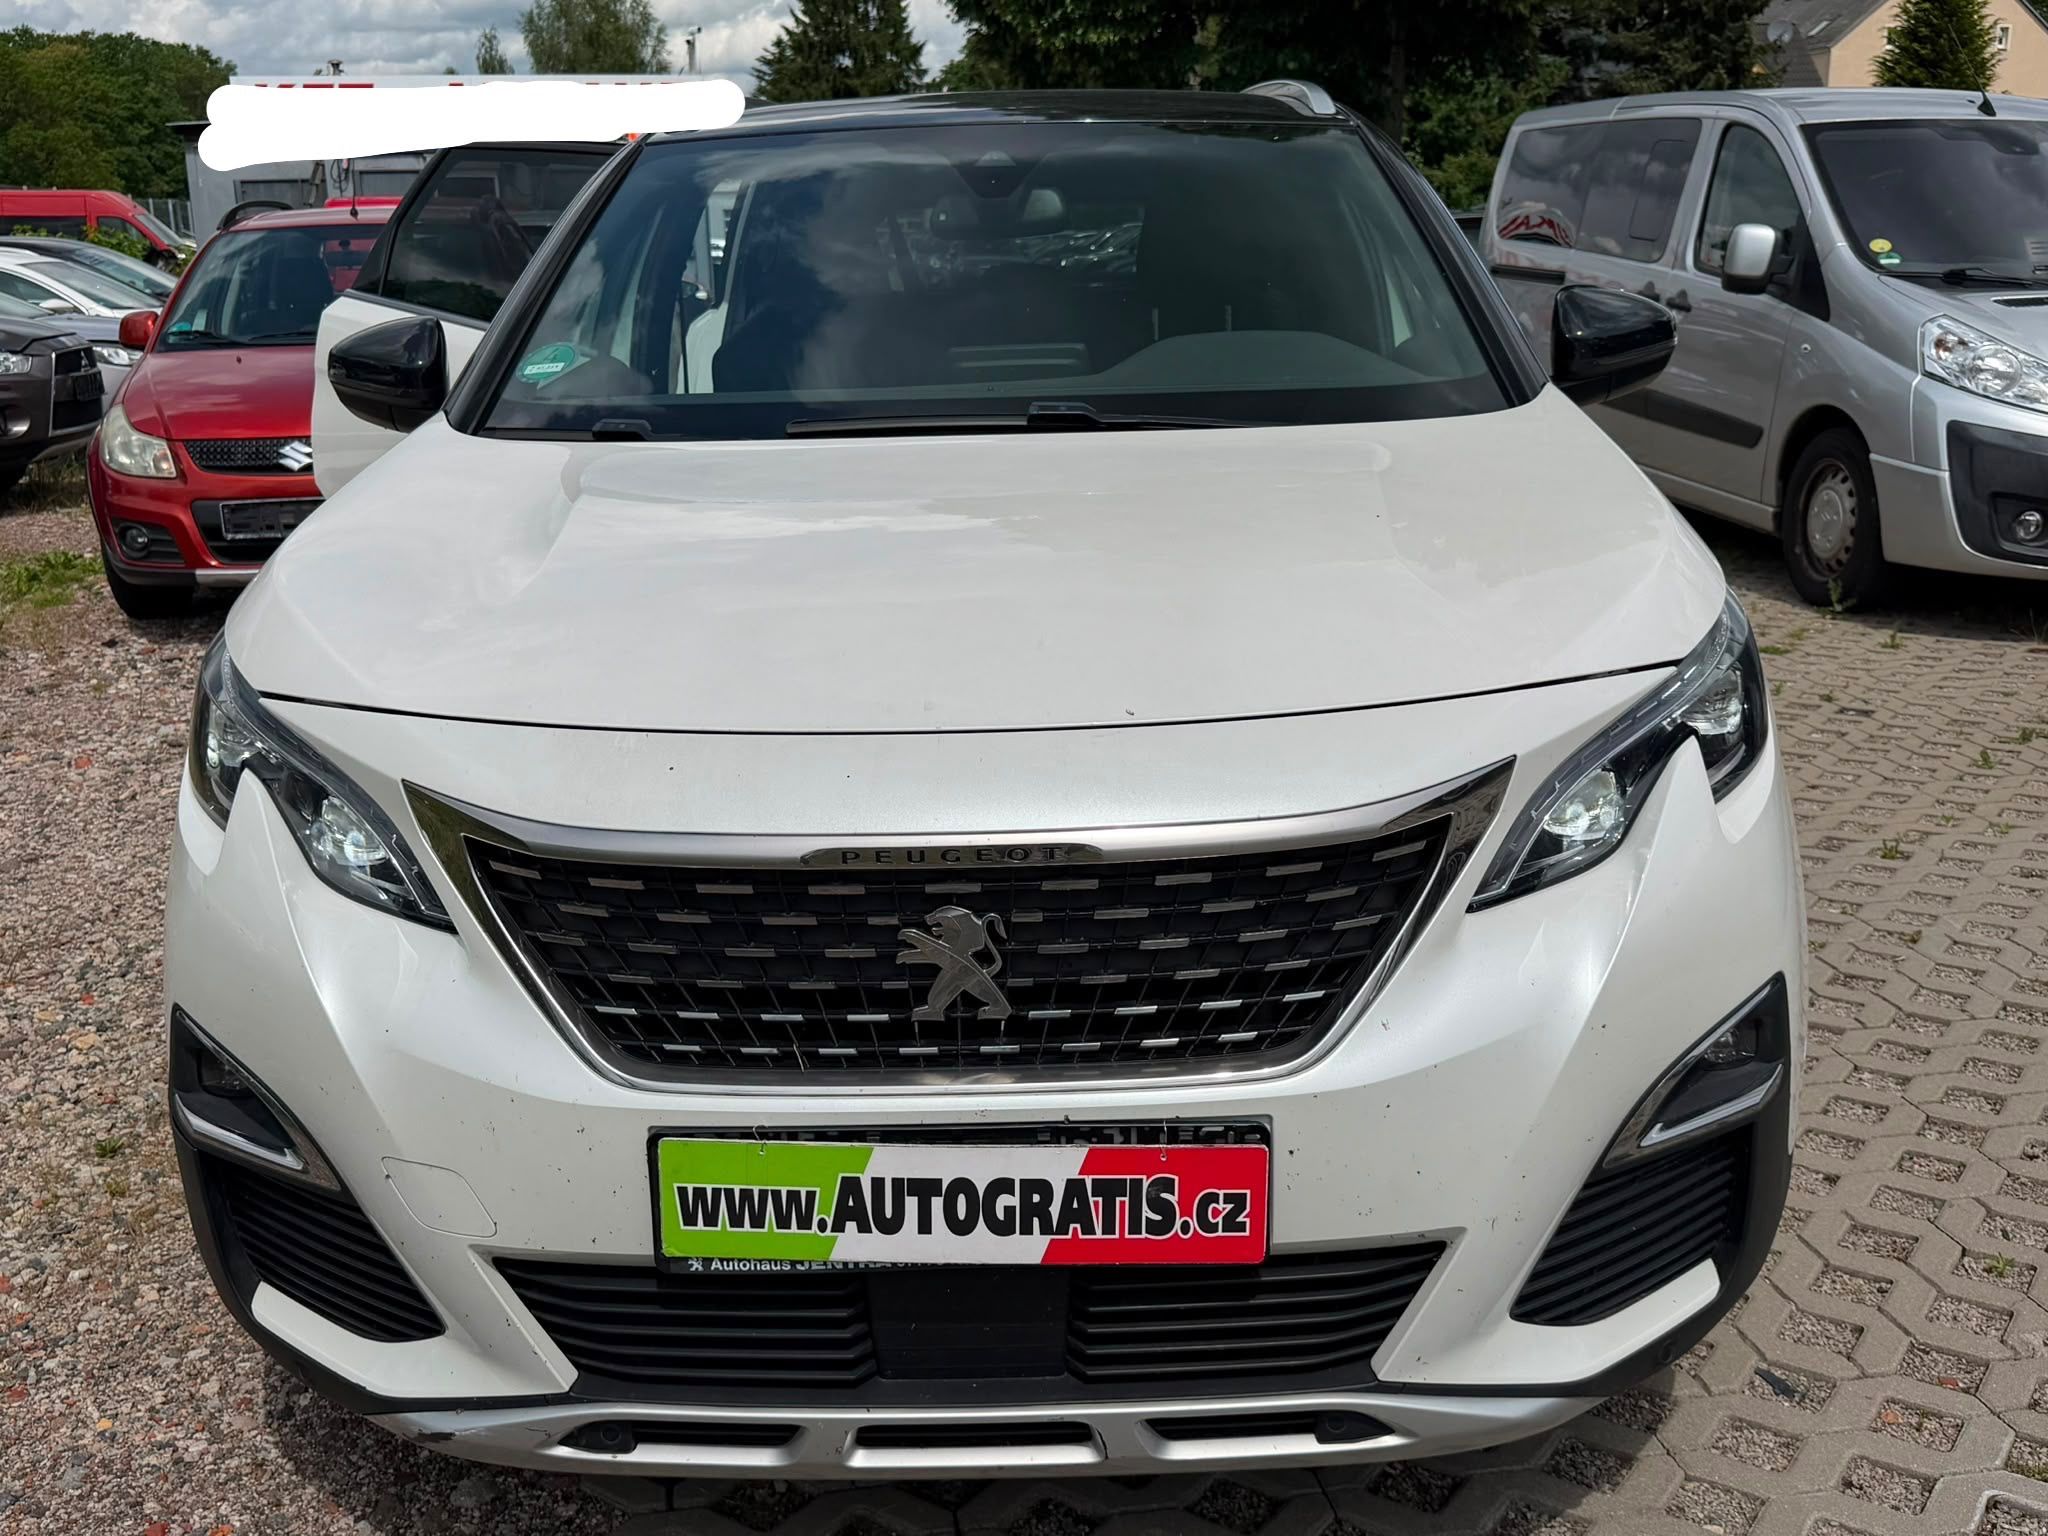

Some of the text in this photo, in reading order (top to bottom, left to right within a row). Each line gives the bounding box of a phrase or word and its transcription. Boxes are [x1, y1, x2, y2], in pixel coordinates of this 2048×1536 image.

[841, 846, 1067, 865] PEUGEOT
[675, 1174, 1249, 1239] www.AUTOGRATIS.cz
[710, 1258, 792, 1271] Autohaus
